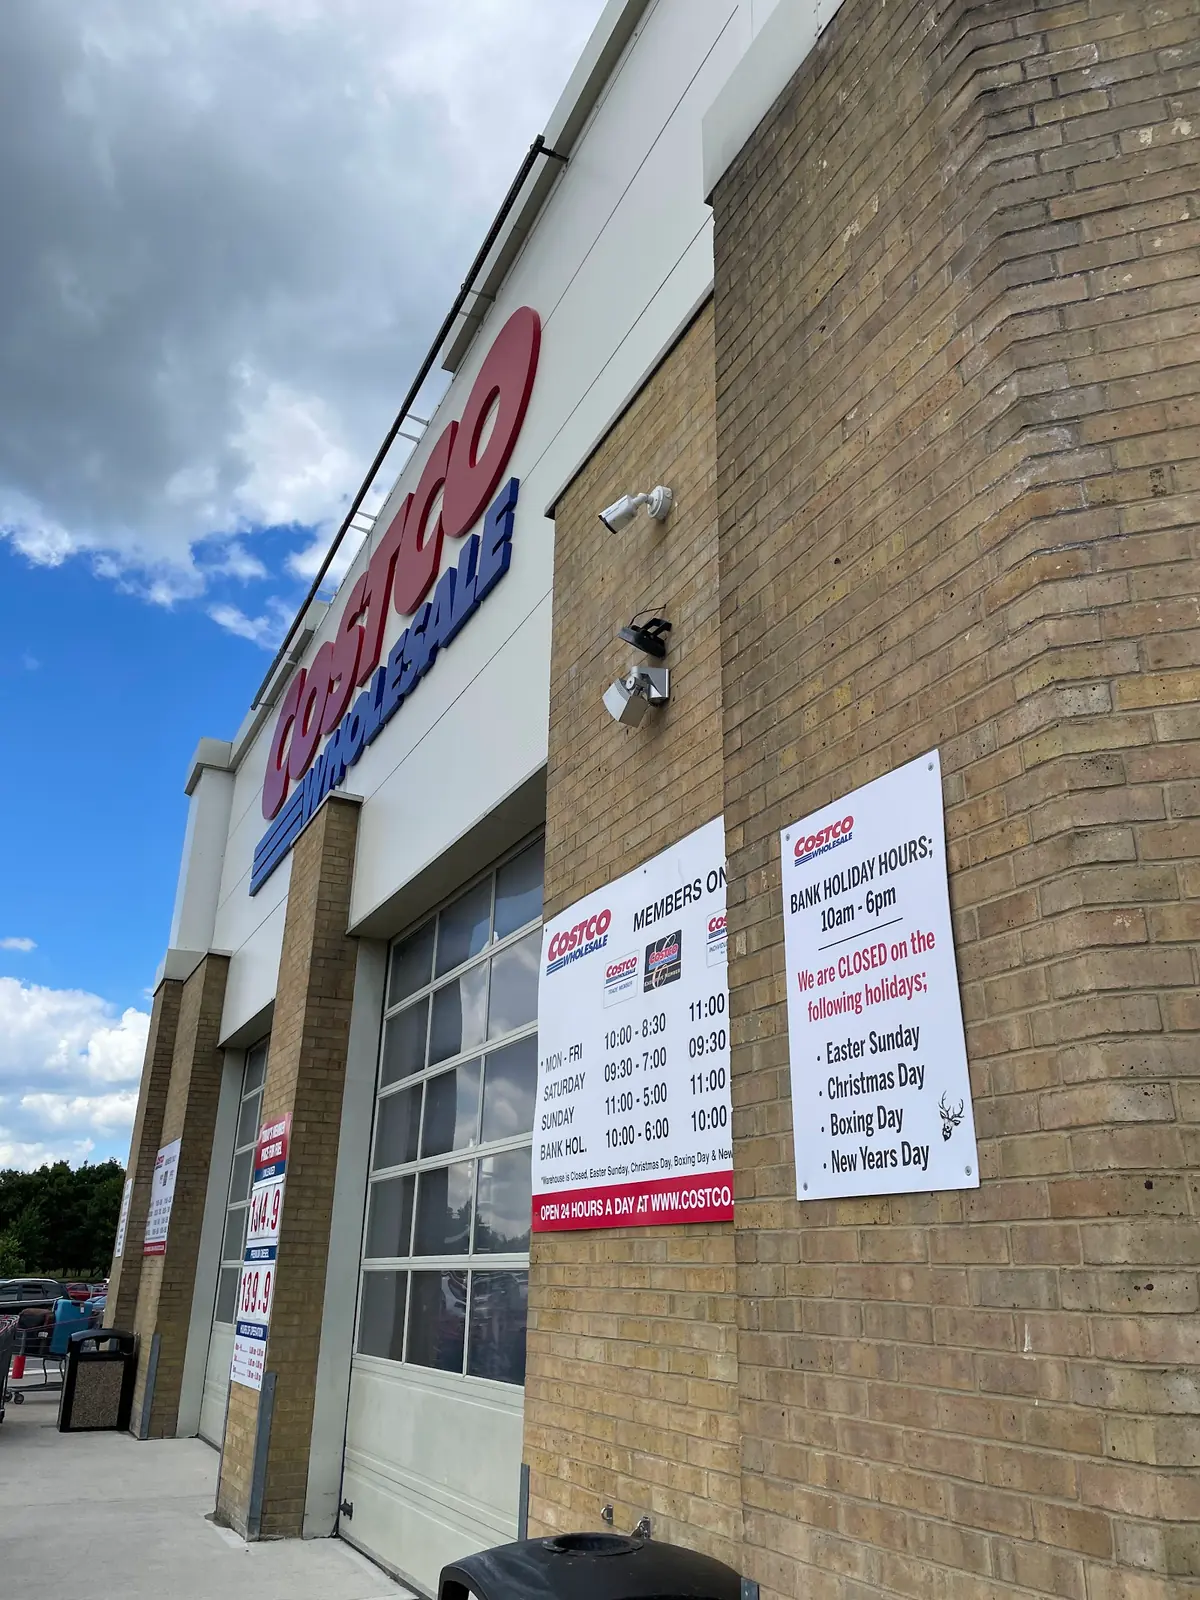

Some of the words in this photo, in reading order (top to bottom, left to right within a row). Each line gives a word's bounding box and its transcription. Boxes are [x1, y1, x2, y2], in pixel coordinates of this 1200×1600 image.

[262, 306, 541, 820] COSTCO
[301, 477, 519, 826] WHOLESALE
[794, 815, 854, 857] COSTCO
[812, 832, 853, 858] WHOLESALE
[790, 882, 821, 914] BANK
[823, 857, 875, 900] HOLIDAY
[879, 835, 933, 877] HOURS;
[633, 878, 702, 932] MEMBERS
[820, 903, 855, 932] 10am
[865, 886, 897, 916] 6pm
[548, 908, 611, 961] COSTCO
[563, 934, 608, 967] WHOLESALE
[649, 943, 679, 964] COSTCO
[606, 956, 637, 978] COSTCO
[797, 969, 814, 992] We
[817, 966, 835, 986] are
[838, 942, 888, 979] CLOSED
[891, 943, 908, 962] on
[910, 930, 935, 954] the
[807, 991, 863, 1022] following
[865, 971, 928, 1006] holidays;
[545, 1051, 562, 1073] MON
[569, 1042, 582, 1063] FRI
[604, 1025, 632, 1050] 10:00
[642, 1012, 666, 1038] 8:30
[689, 993, 725, 1021] 11:00
[826, 1037, 866, 1064] Easter
[869, 1024, 920, 1055] Sunday
[543, 1071, 585, 1101] SATURDAY
[604, 1057, 632, 1082] 09:30
[642, 1046, 667, 1071] 7:00
[689, 1029, 726, 1058] 09:30
[827, 1071, 895, 1100] Christmas
[898, 1062, 925, 1090] Day
[541, 1106, 575, 1131] SUNDAY
[605, 1091, 633, 1115] 11:00
[643, 1082, 667, 1107] 5:00
[690, 1067, 726, 1095] 11:00
[830, 1110, 874, 1137] Boxing
[877, 1105, 904, 1133] Day
[540, 1140, 563, 1160] BANK
[566, 1136, 587, 1155] HOL.
[605, 1125, 635, 1149] 10:00
[645, 1117, 669, 1141] 6:00
[691, 1105, 727, 1132] 10:00
[566, 1173, 570, 1182] is
[590, 1168, 607, 1179] Easter
[631, 1160, 659, 1173] Christmas
[674, 1154, 696, 1167] Boxing
[697, 1151, 710, 1165] Day
[711, 1149, 717, 1161] &
[718, 1148, 733, 1161] New
[831, 1149, 857, 1174] New
[859, 1145, 898, 1172] Years
[901, 1140, 930, 1171] Day
[540, 1203, 560, 1221] OPEN
[561, 1203, 570, 1219] 24
[571, 1198, 603, 1218] HOURS
[605, 1198, 613, 1215] A
[614, 1196, 635, 1215] DAY
[637, 1195, 649, 1213] AT
[240, 1271, 271, 1314] 139.9
